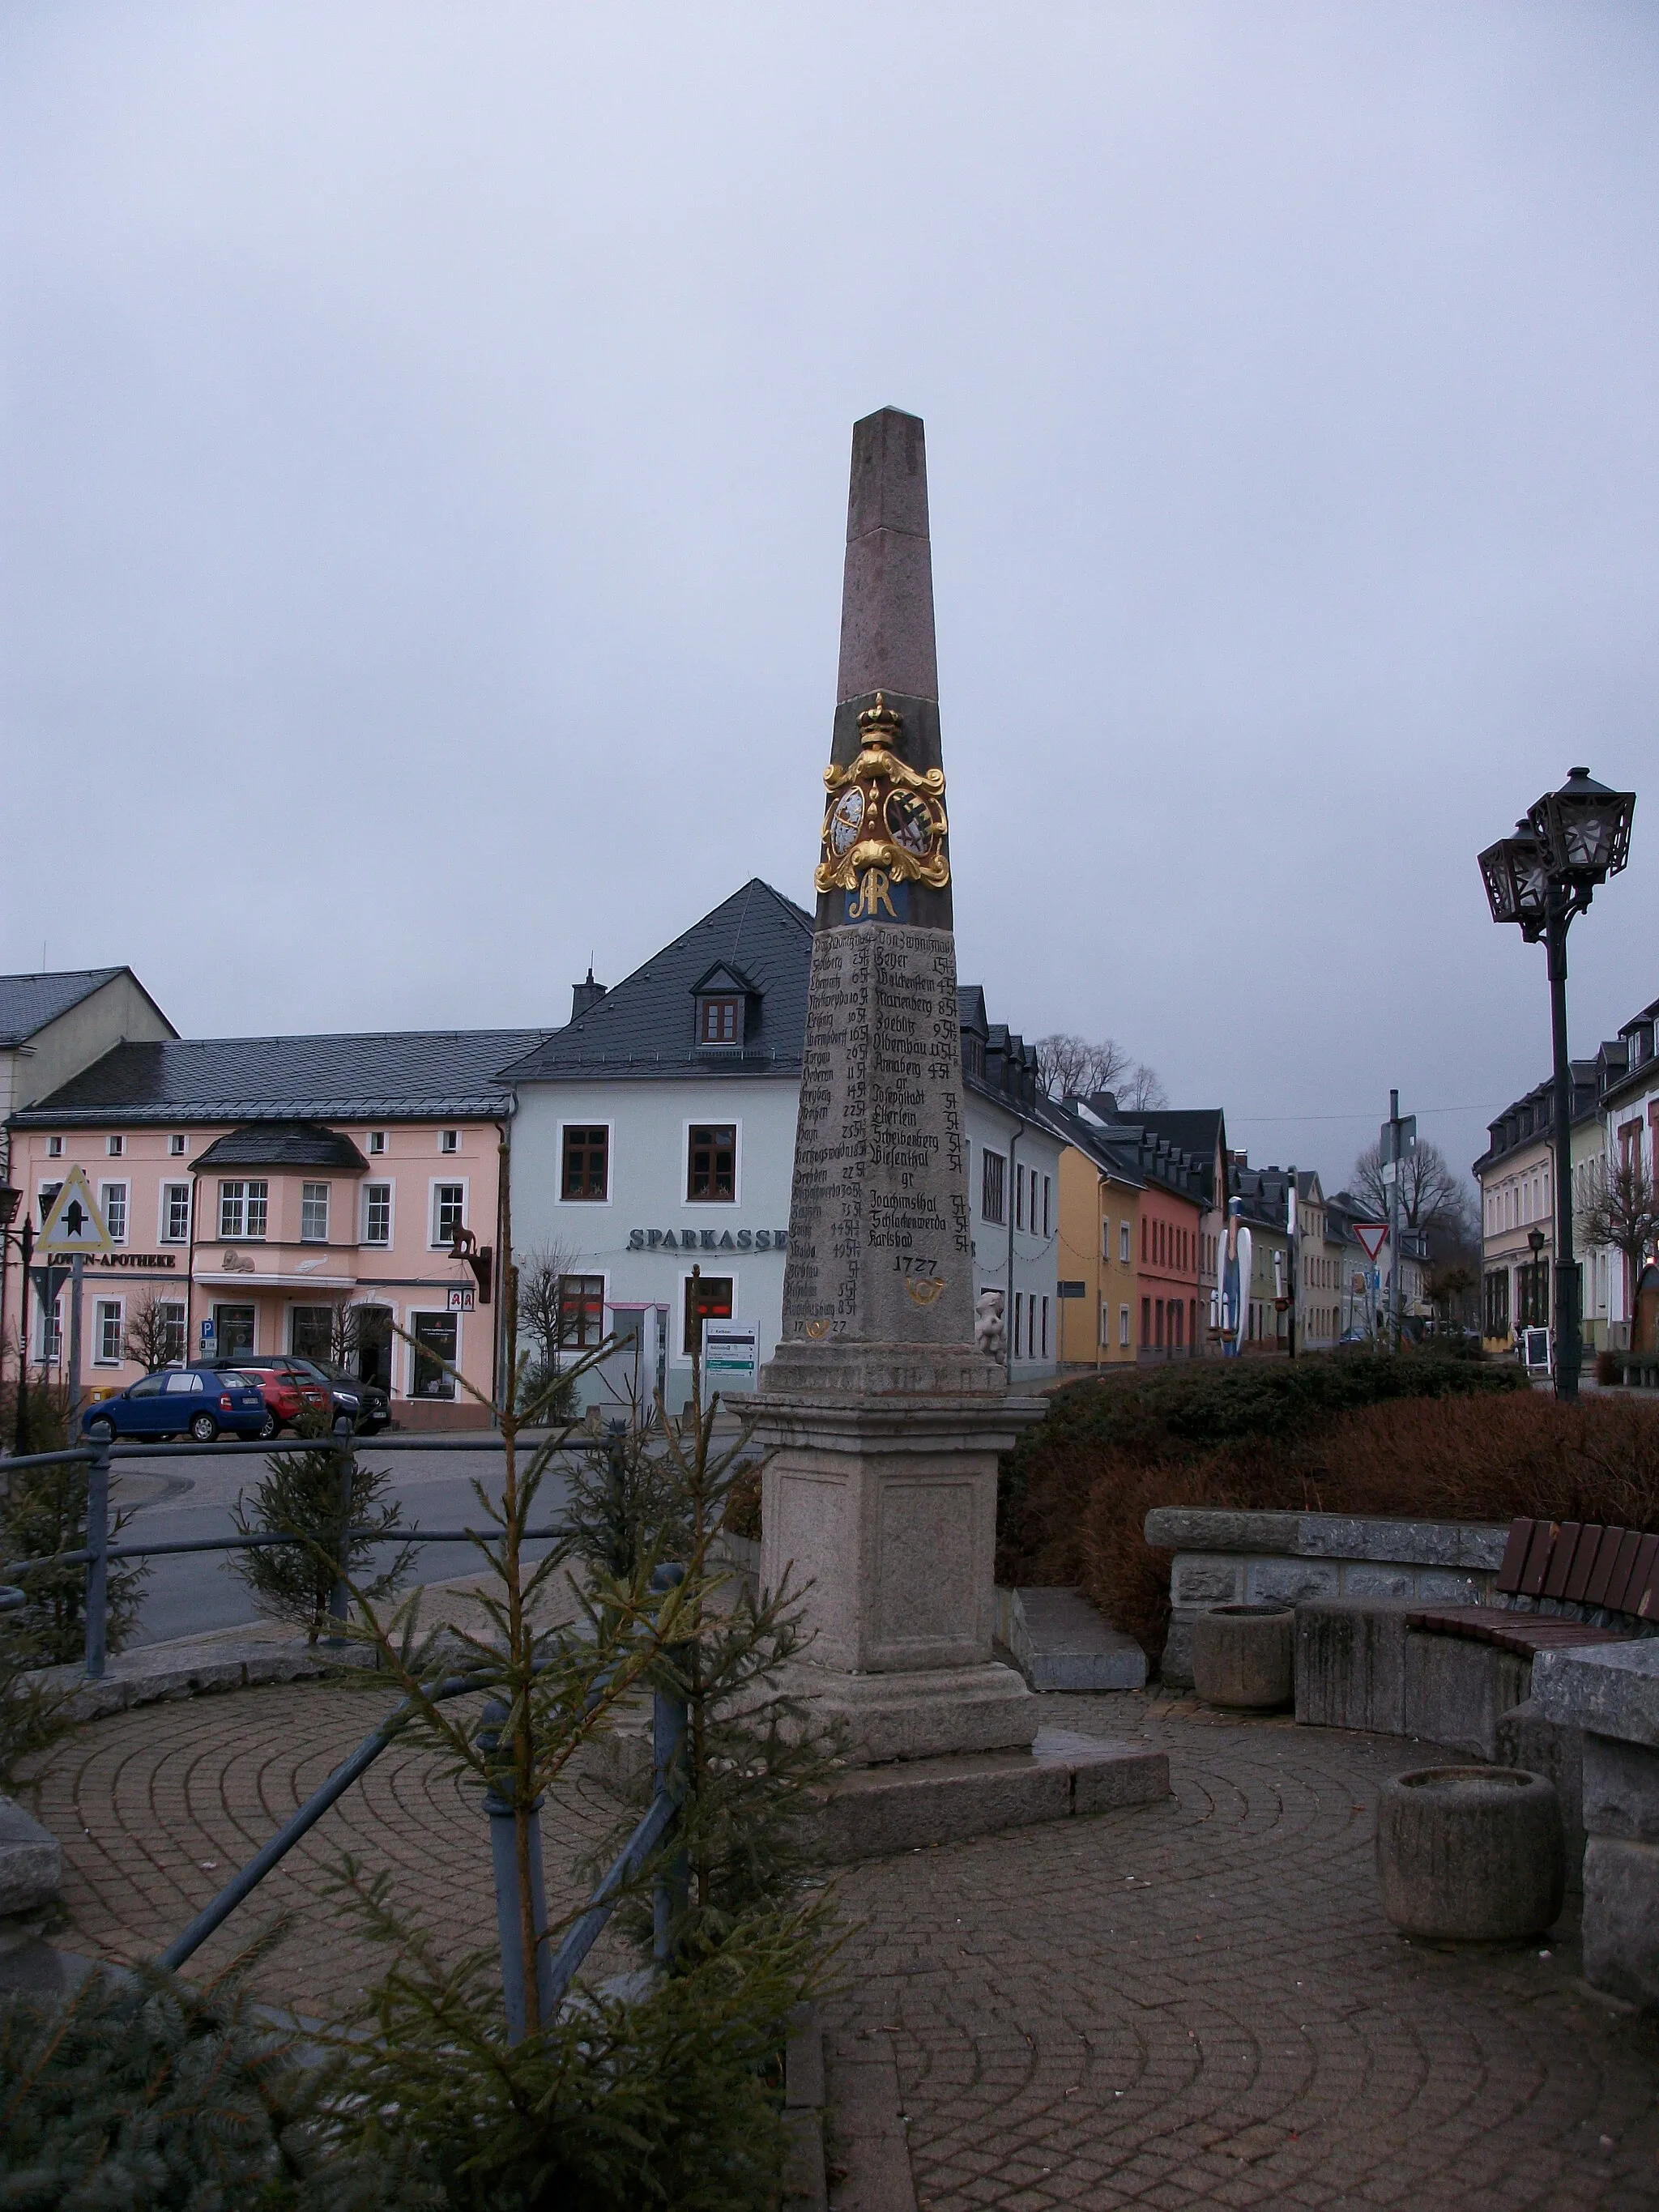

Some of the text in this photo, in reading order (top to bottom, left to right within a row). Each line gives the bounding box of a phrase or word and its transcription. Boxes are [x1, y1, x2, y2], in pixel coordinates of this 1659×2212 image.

[875, 988, 932, 1019] Marienberg
[874, 1051, 922, 1078] Annaberg
[629, 1229, 789, 1249] SPARKASSE
[868, 1230, 913, 1247] Karlsbad
[893, 1255, 938, 1276] 1727
